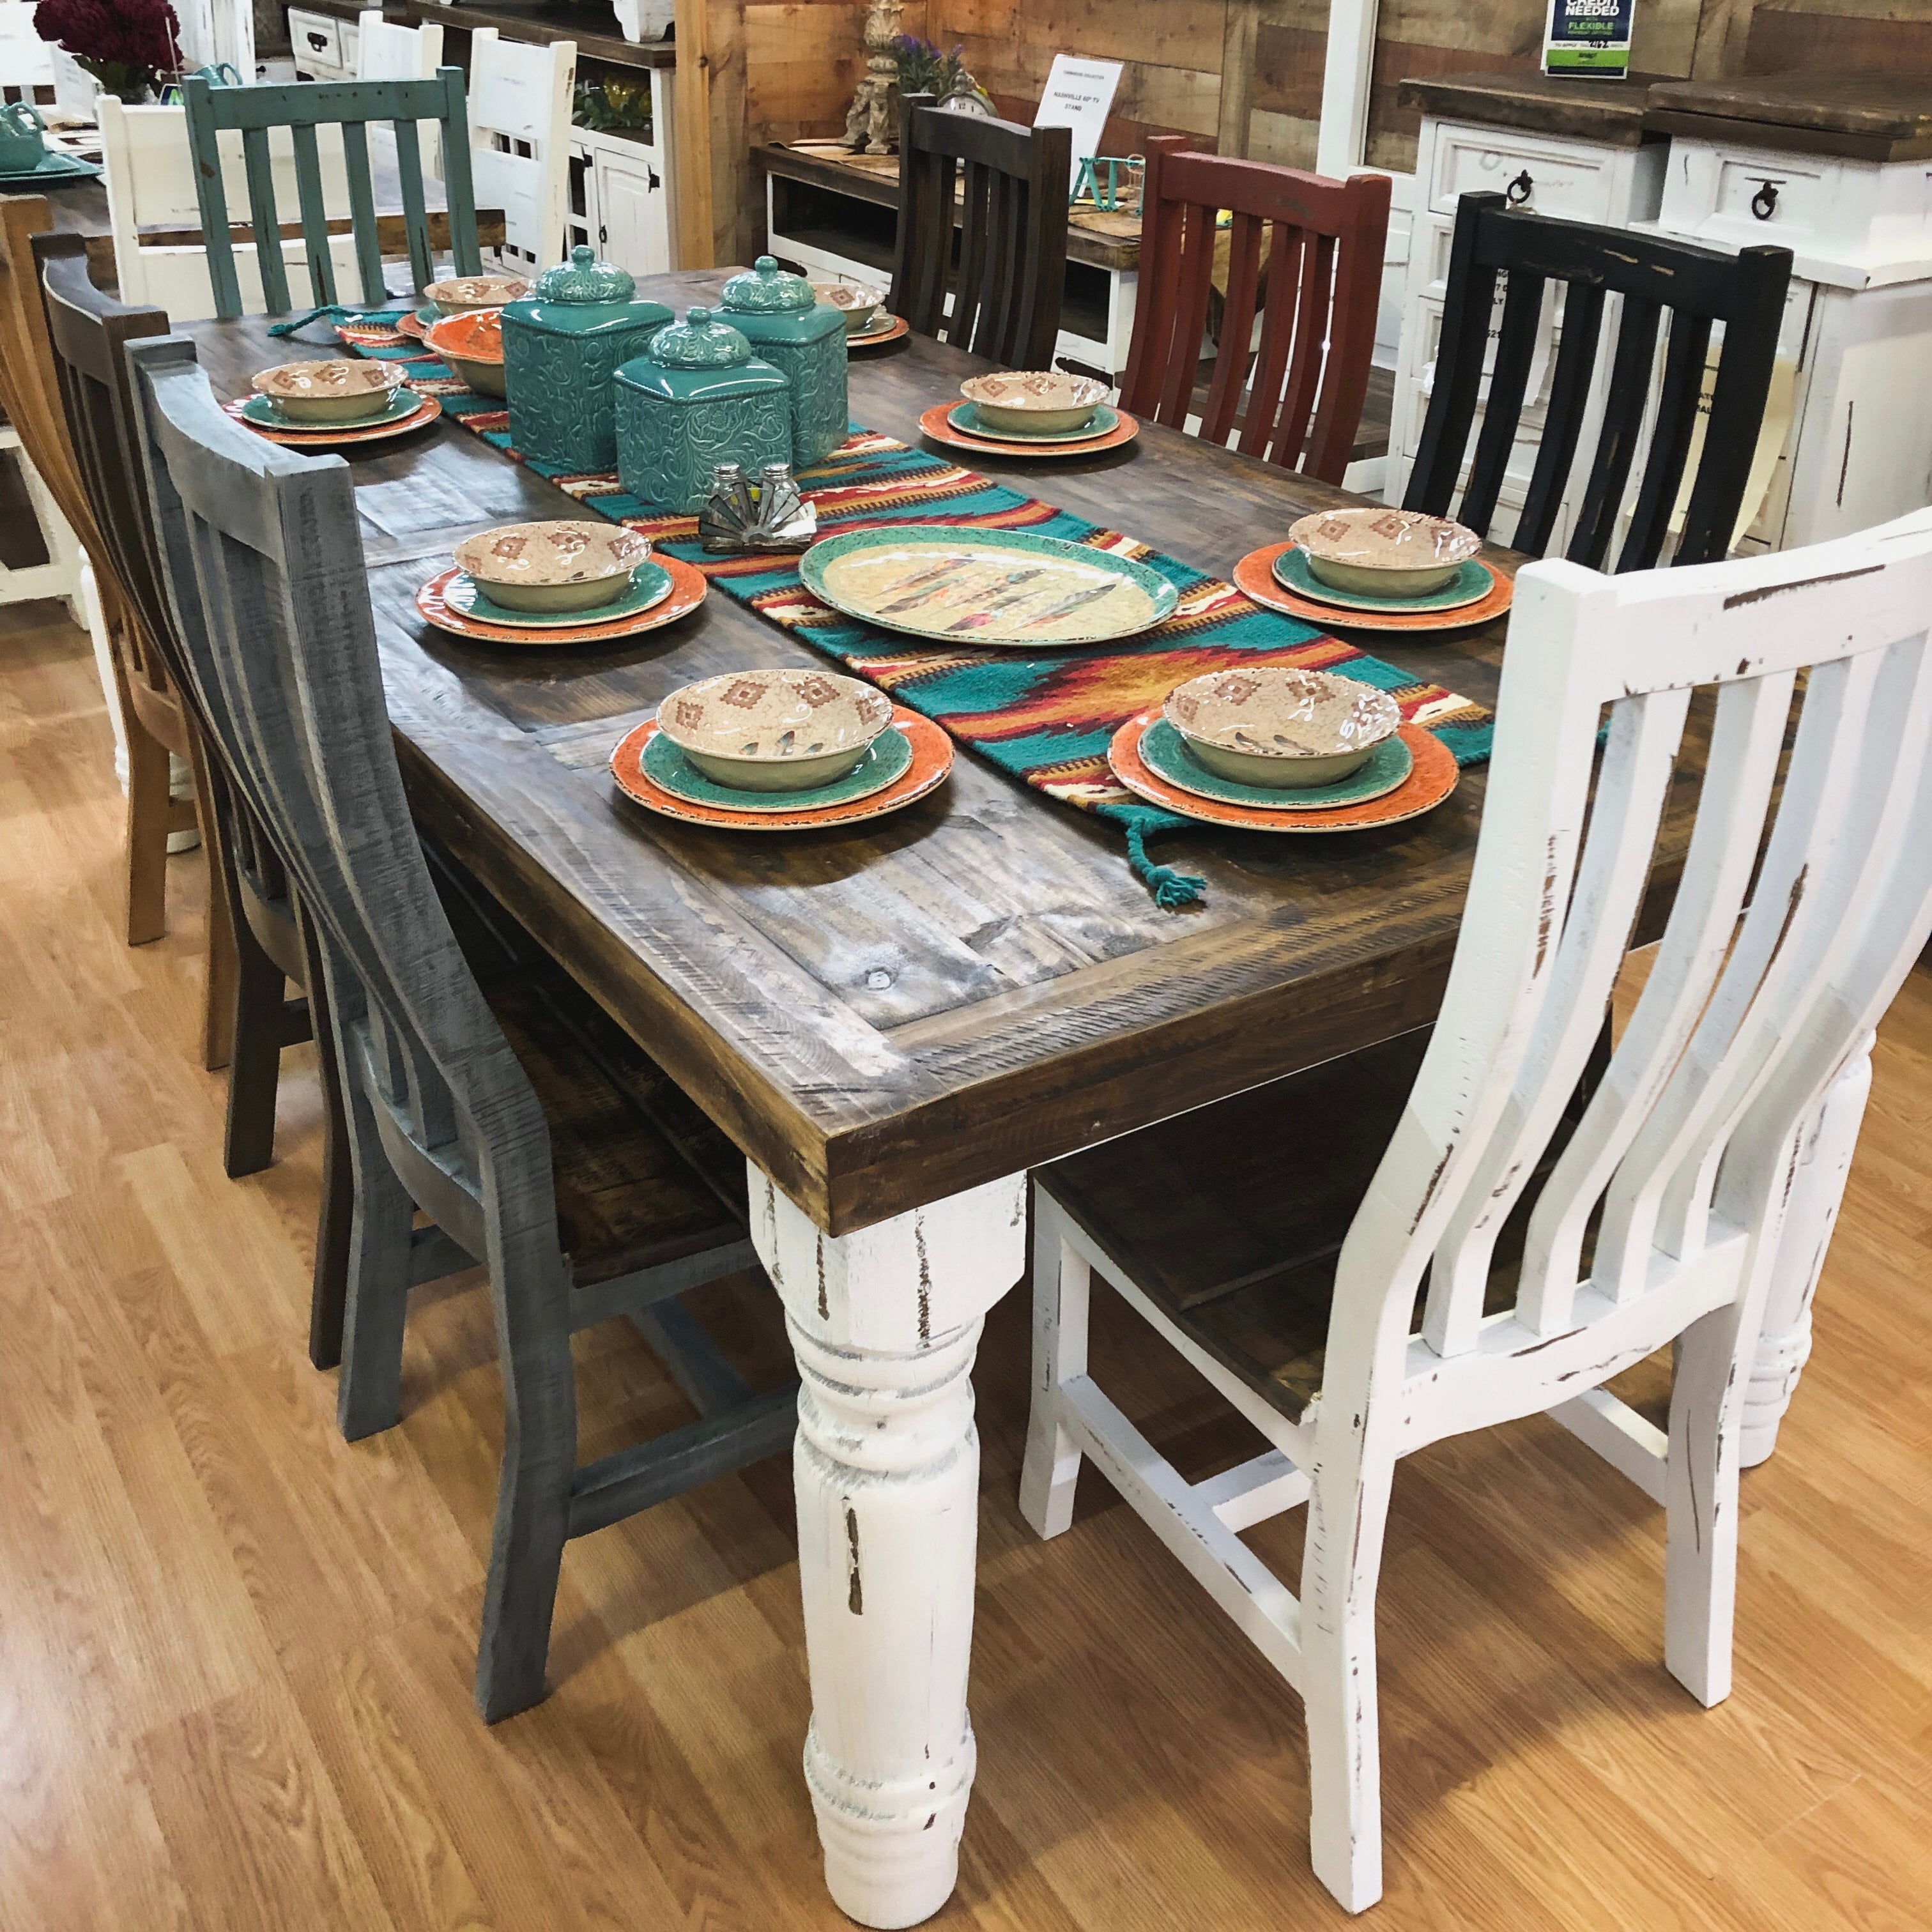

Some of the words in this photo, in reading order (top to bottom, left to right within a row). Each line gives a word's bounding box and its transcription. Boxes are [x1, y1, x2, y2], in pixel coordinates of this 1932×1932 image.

[1565, 6, 1620, 16] NEEDED
[1568, 22, 1614, 30] FLEXIBLE
[1054, 91, 1082, 101] NASHVILLE
[1064, 103, 1082, 112] STAND
